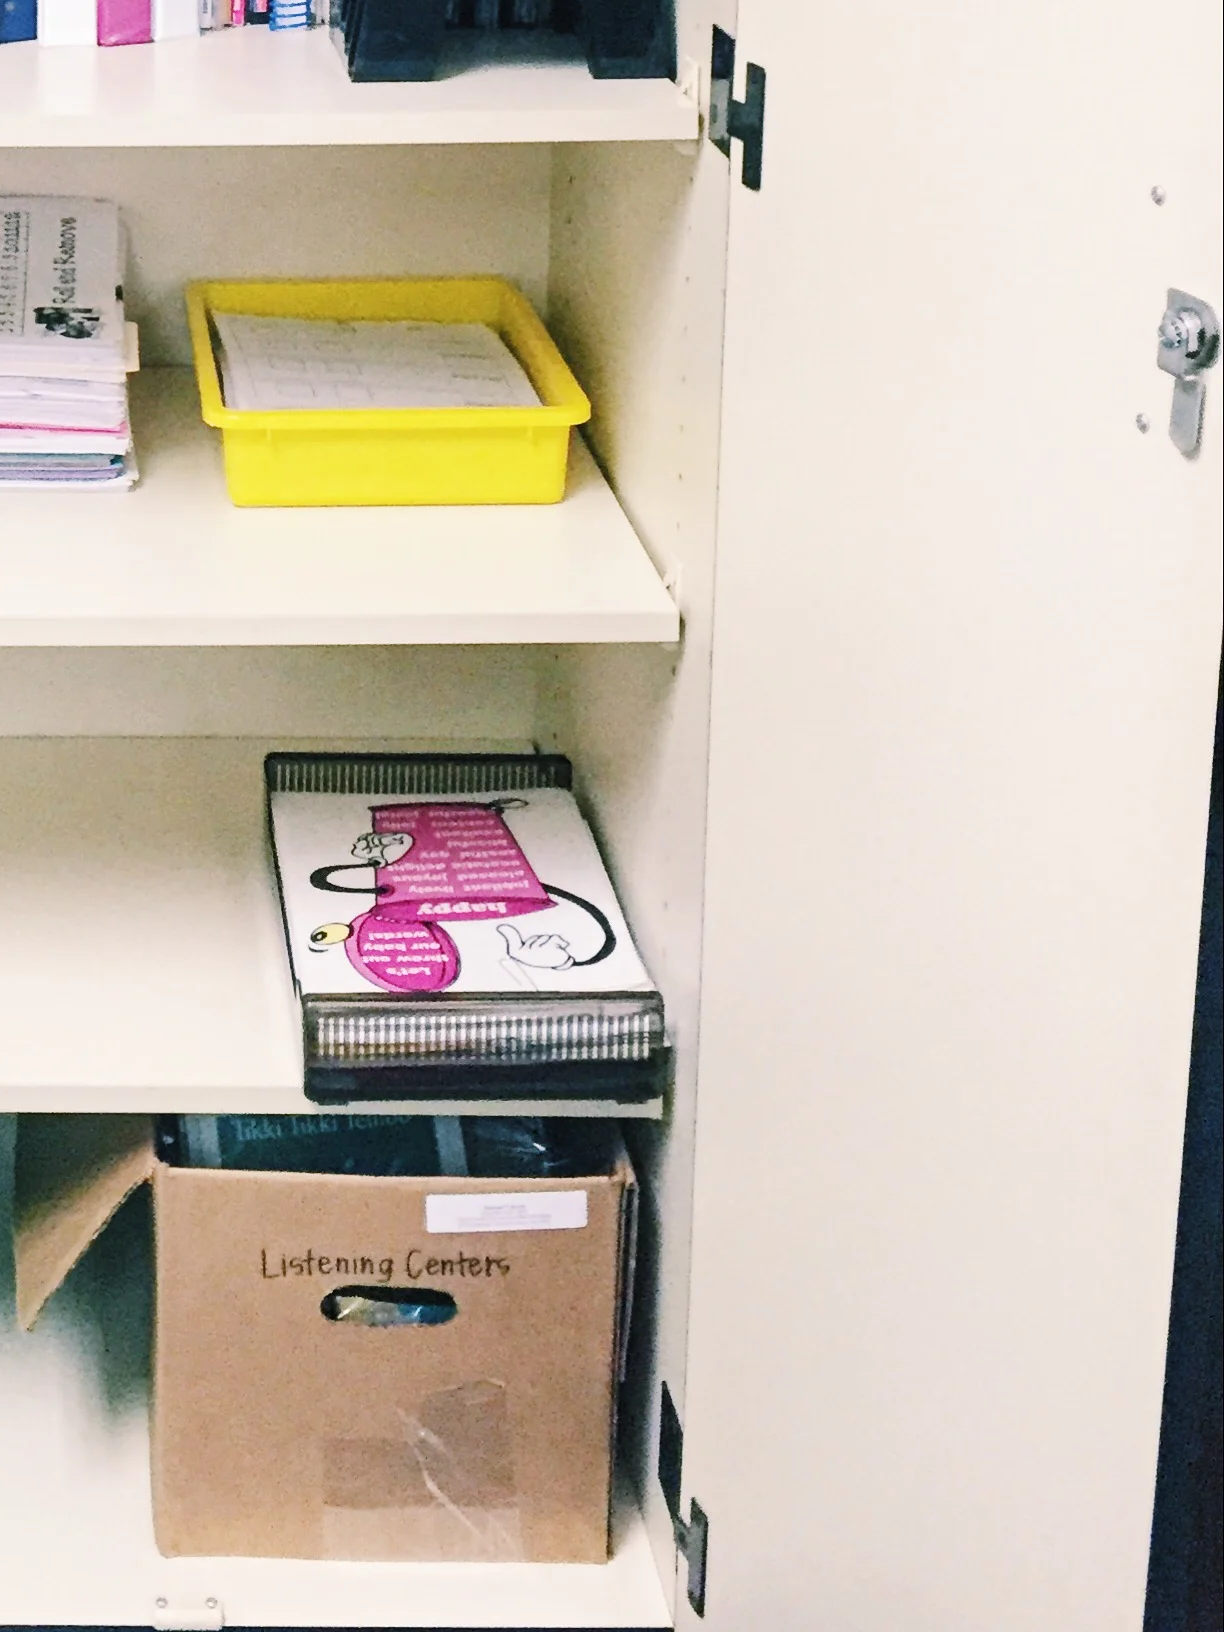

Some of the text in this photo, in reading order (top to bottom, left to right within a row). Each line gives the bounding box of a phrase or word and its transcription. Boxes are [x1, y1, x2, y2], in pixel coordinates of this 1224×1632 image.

[416, 901, 508, 915] happy
[363, 941, 441, 952] our baby
[361, 953, 450, 964] throw out
[385, 967, 432, 976] Let's
[260, 1247, 512, 1283] Listening Centers
